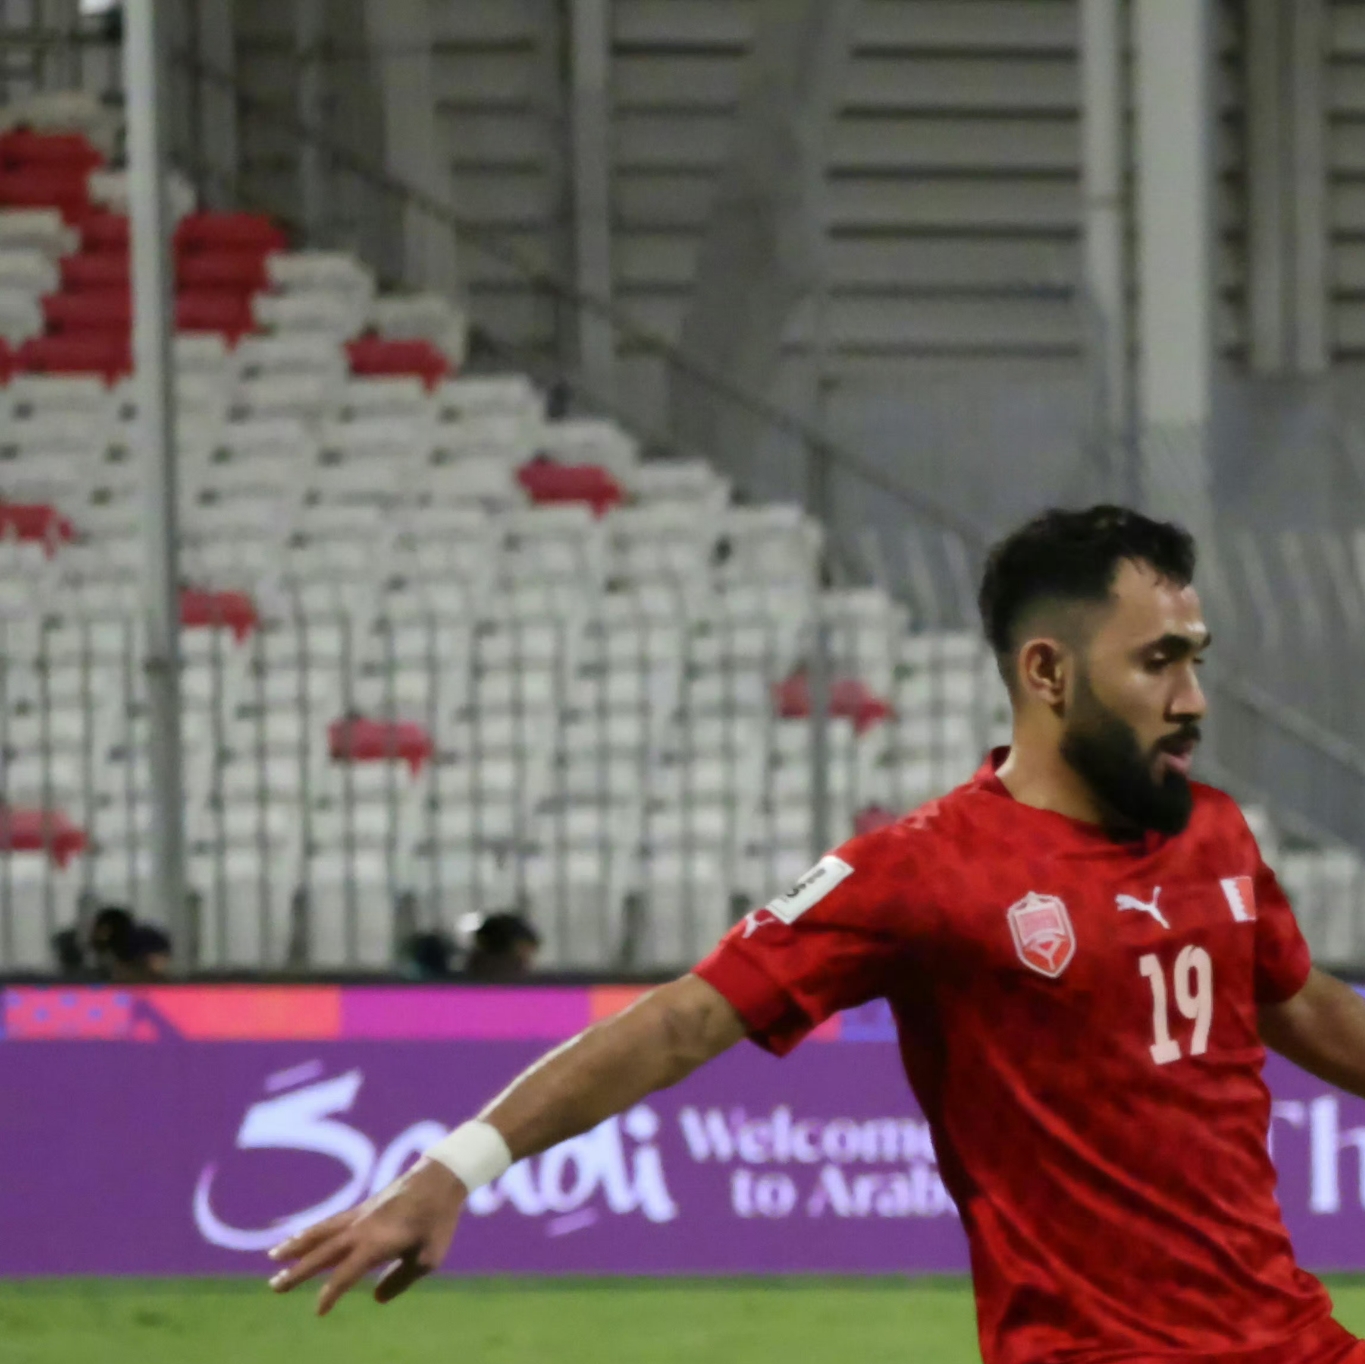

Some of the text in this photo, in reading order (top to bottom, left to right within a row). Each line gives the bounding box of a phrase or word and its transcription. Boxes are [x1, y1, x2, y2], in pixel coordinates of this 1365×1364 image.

[1139, 944, 1214, 1065] 19
[731, 1164, 960, 1218] to Arab
